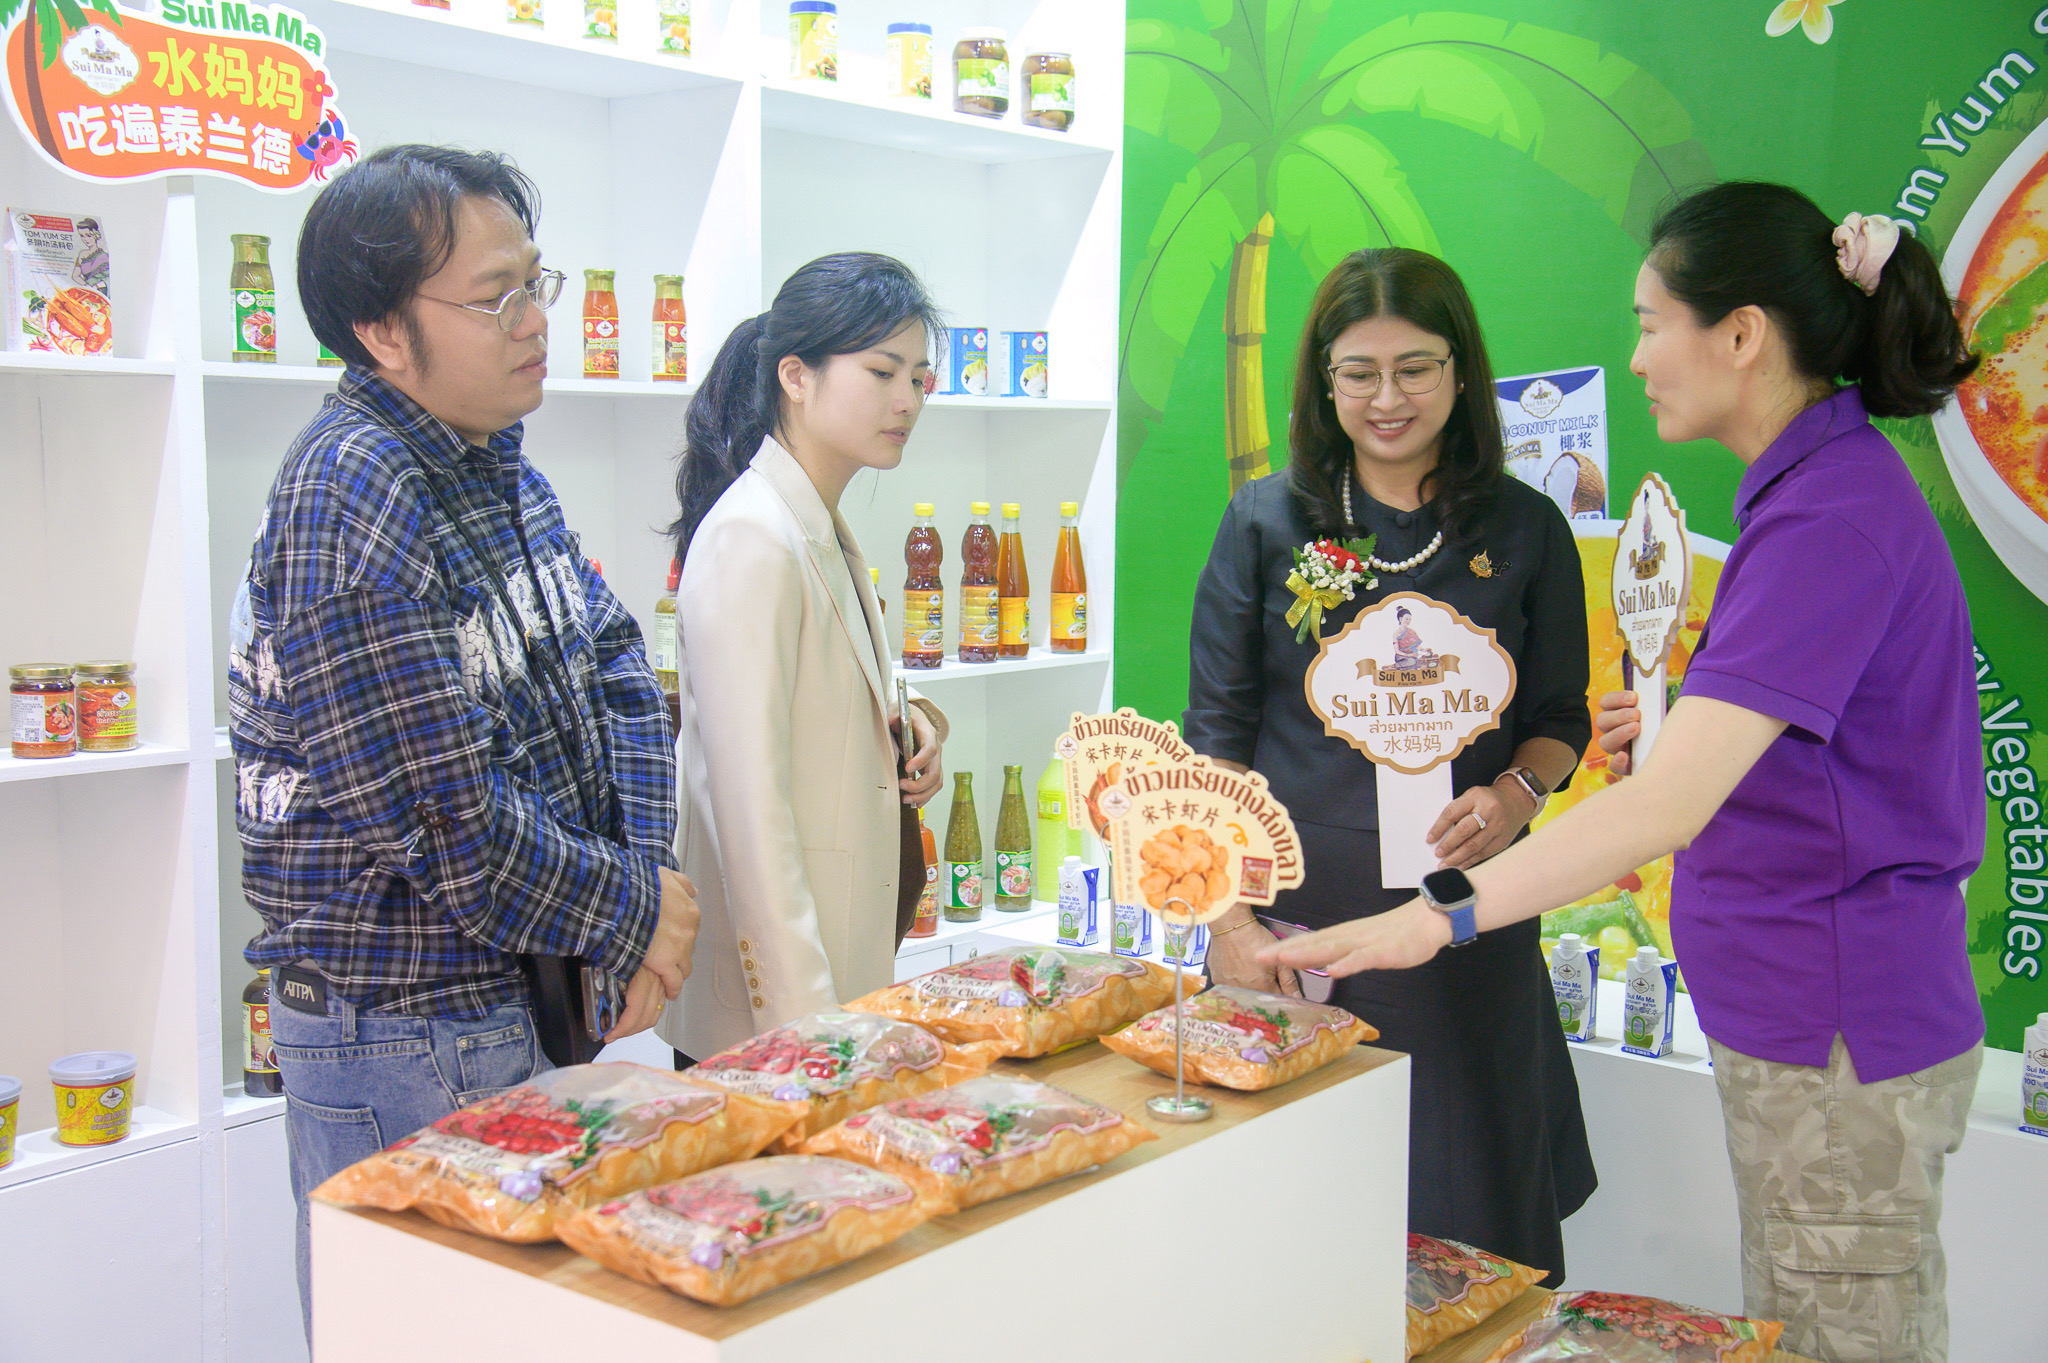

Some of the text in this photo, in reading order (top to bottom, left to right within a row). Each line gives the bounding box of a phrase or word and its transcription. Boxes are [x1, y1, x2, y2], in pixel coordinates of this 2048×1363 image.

[162, 0, 322, 57] Sui Ma Ma
[72, 60, 91, 73] Sui
[93, 62, 112, 75] Ma
[114, 65, 133, 78] Ma
[147, 37, 304, 121] 水妈妈
[1921, 52, 2036, 153] Yum
[57, 103, 293, 177] 吃遍泰兰德
[23, 229, 73, 241] TOM YUM SET
[1559, 414, 1599, 432] MILK
[1560, 432, 1593, 451] 椰浆
[1619, 580, 1677, 616] Sui Ma Ma
[1378, 669, 1438, 682] Sui Ma Ma
[1331, 688, 1491, 719] Sui Ma Ma
[1383, 734, 1443, 755] 水妈妈
[1141, 798, 1220, 829] 宋卡虾片
[1982, 698, 2048, 978] Vegetables
[1636, 994, 1644, 1002] Ma
[2026, 1065, 2037, 1073] Sui
